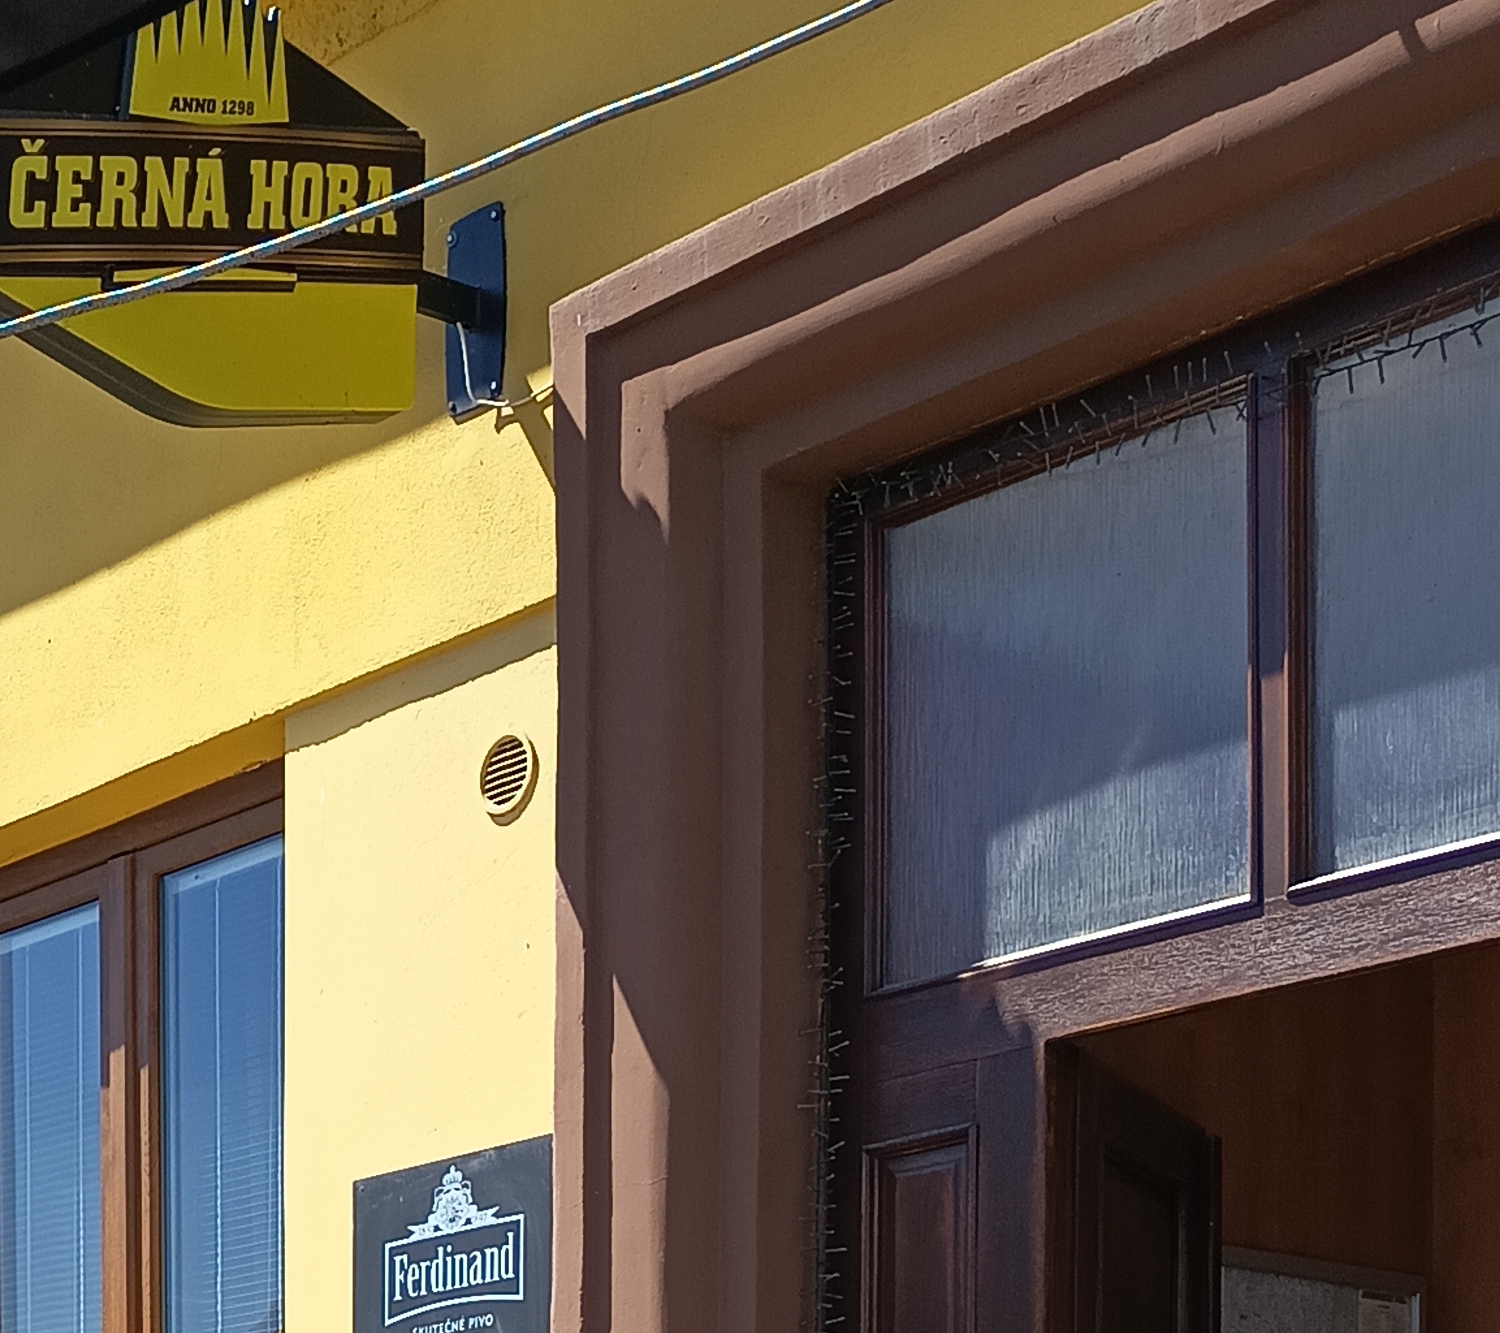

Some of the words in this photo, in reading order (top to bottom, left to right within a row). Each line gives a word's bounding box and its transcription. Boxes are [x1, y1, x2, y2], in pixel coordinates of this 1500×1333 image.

[169, 96, 216, 115] ANNO
[221, 99, 255, 116] 1298
[8, 139, 229, 230] ČERNÁ
[247, 158, 398, 236] HORA
[393, 1232, 515, 1301] Ferdinand
[468, 1314, 494, 1330] PIVO
